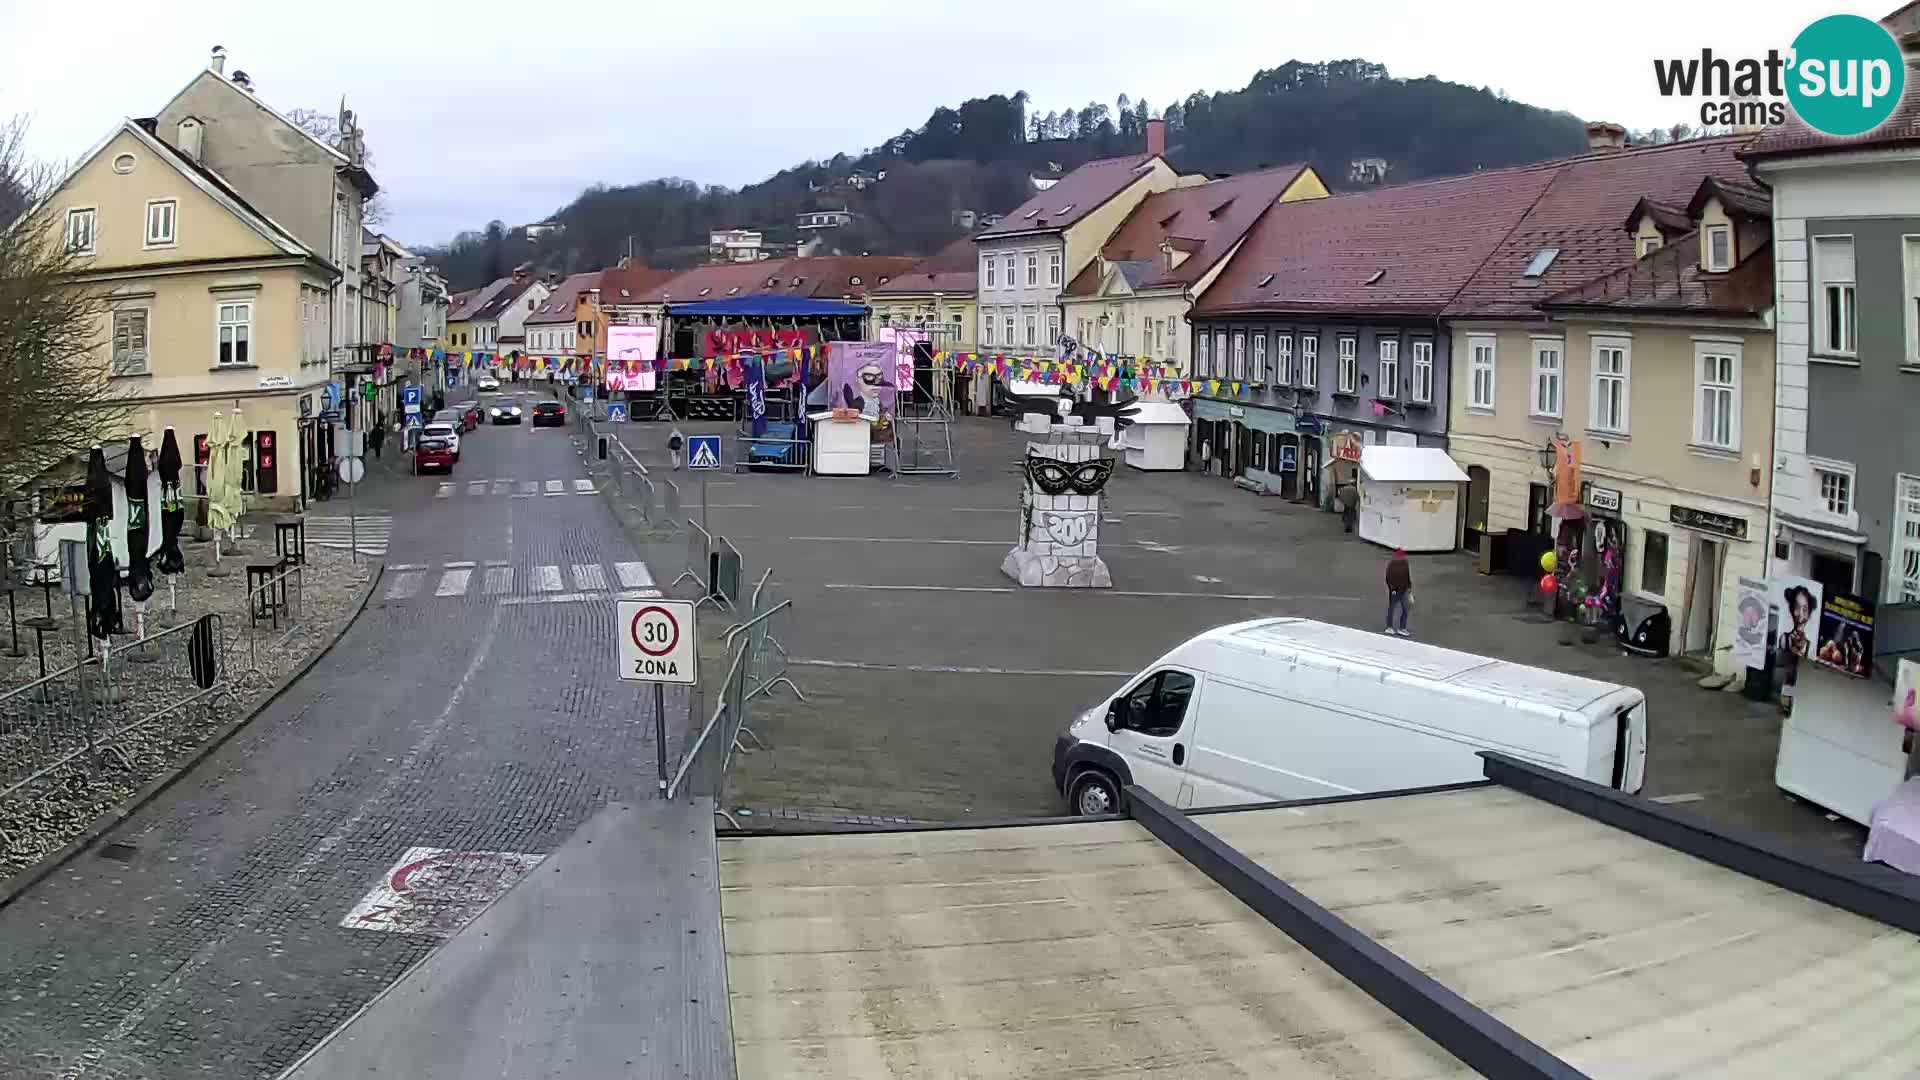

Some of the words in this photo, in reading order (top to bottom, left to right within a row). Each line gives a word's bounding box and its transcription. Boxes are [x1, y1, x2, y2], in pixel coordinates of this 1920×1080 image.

[408, 392, 416, 402] P
[644, 622, 668, 643] 30
[635, 660, 678, 676] ZONA
